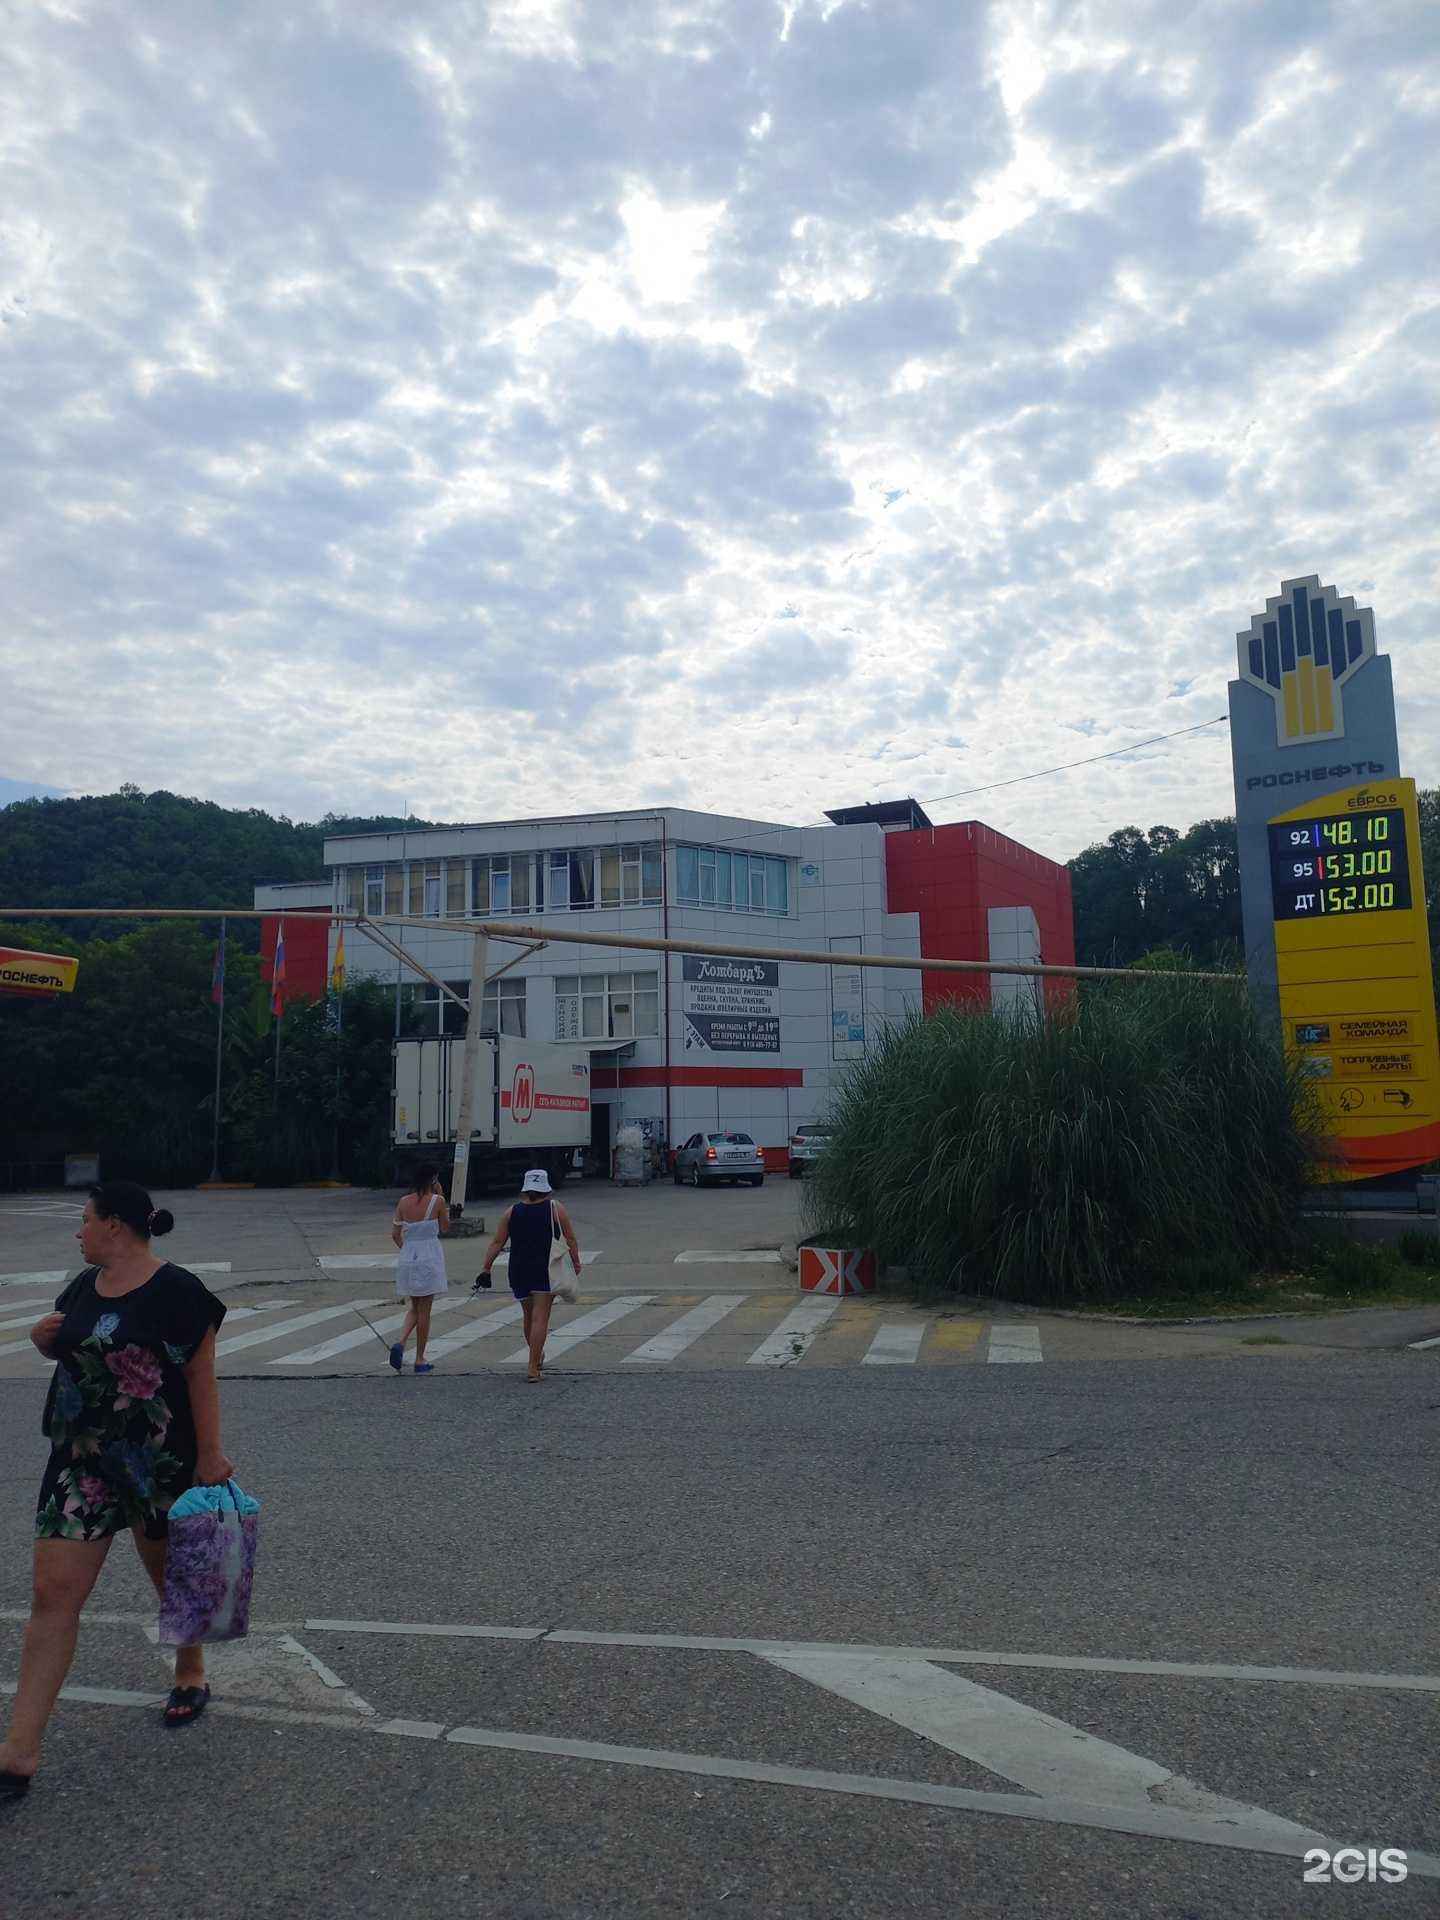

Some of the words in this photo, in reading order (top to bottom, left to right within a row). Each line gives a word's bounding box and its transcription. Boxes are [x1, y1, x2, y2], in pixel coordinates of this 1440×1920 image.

[1246, 761, 1384, 790] РОСНЕФТЬ
[1290, 831, 1310, 845] 92
[1323, 816, 1388, 845] 48.10
[1293, 863, 1312, 877] 95
[1326, 850, 1391, 879] 53.00
[1295, 894, 1315, 910] ДТ
[1328, 883, 1393, 911] 52.00
[1345, 1028, 1408, 1038] КОМАНДА
[1370, 1062, 1412, 1072] КАРТЫ
